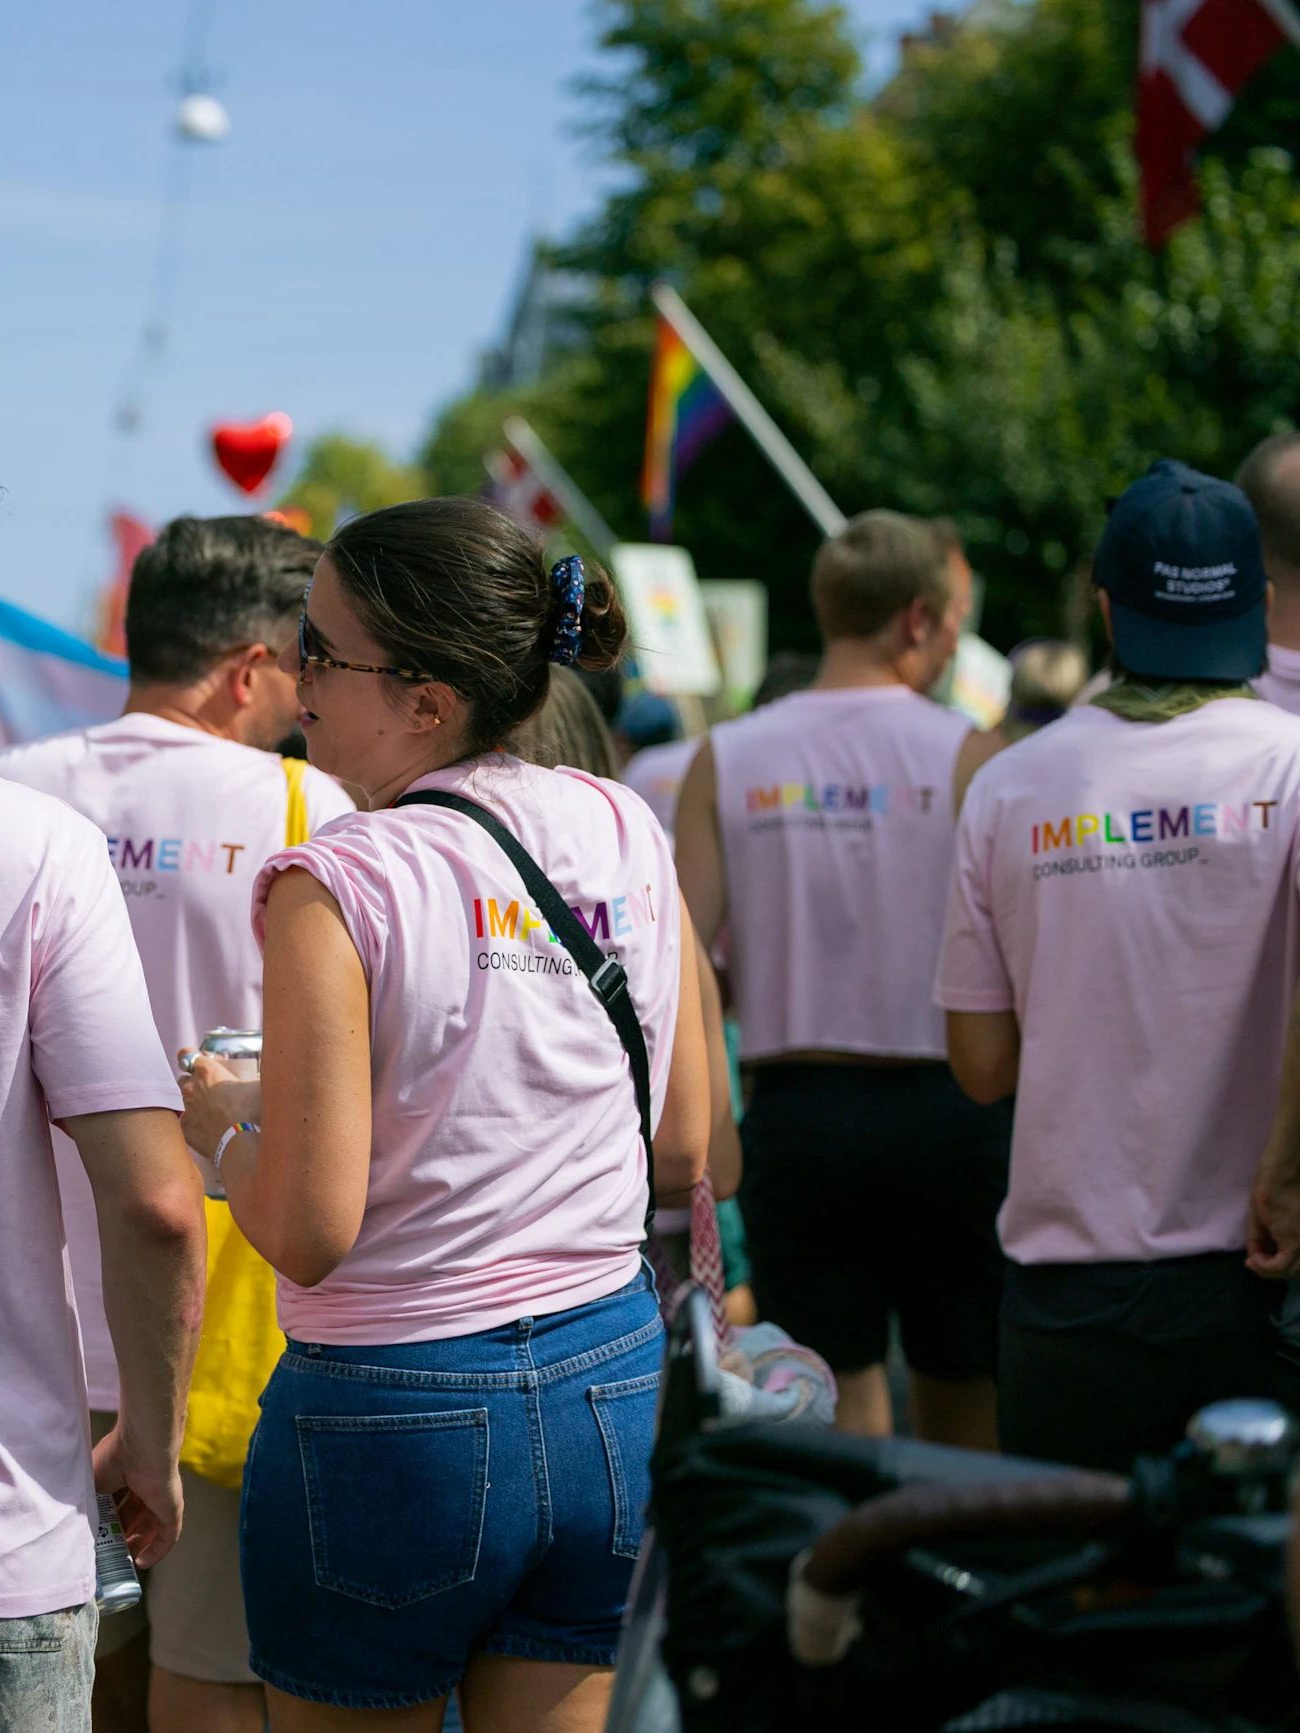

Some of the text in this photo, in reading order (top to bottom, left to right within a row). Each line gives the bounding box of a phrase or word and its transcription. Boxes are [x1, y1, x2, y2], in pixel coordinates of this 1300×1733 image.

[1032, 799, 1278, 855] IMPLEMENT
[1033, 852, 1137, 881] CONSULTING
[477, 952, 574, 976] CONSULTING
